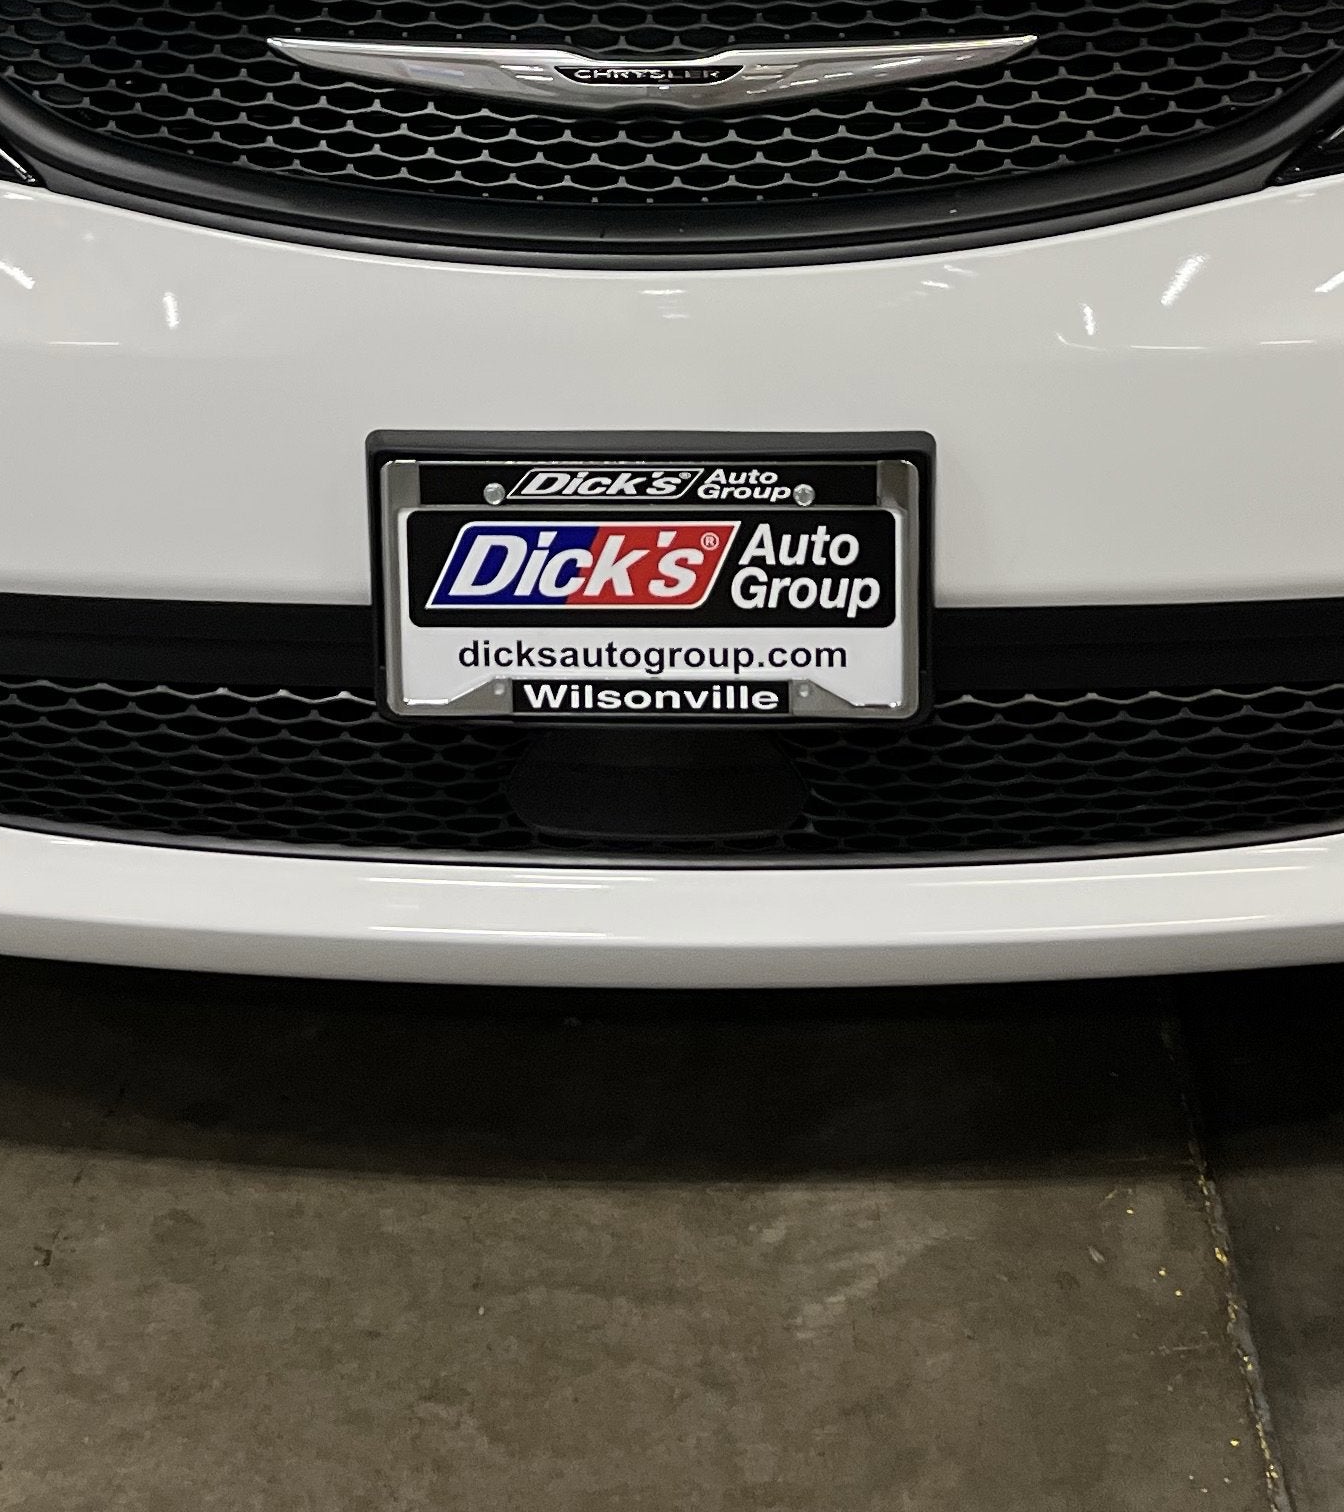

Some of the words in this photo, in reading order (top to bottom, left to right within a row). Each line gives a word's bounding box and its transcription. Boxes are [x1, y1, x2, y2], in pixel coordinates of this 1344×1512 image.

[573, 68, 721, 79] CHRYSLER
[704, 469, 778, 484] Auto
[697, 484, 792, 502] Group
[739, 523, 860, 567] Auto
[731, 568, 881, 617] Group
[458, 640, 848, 673] dicksautogroup.com
[524, 684, 780, 710] Wilsonville
